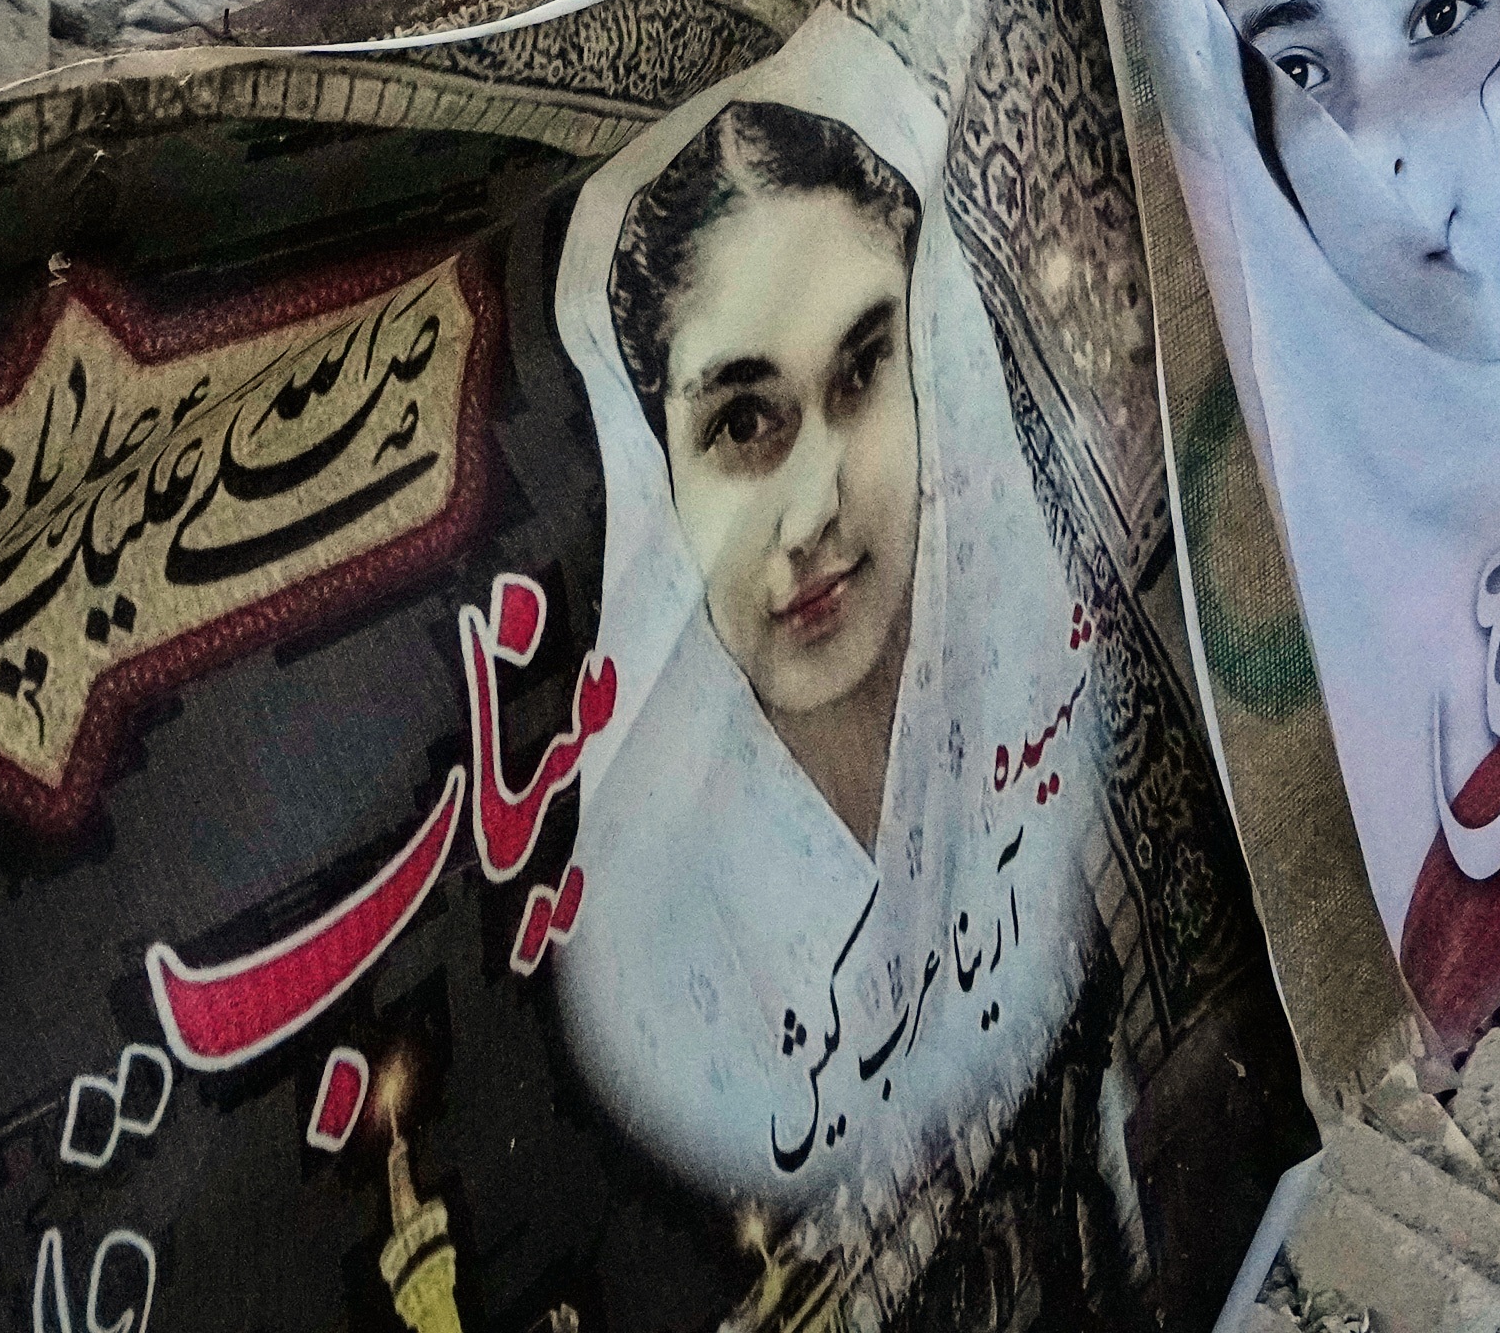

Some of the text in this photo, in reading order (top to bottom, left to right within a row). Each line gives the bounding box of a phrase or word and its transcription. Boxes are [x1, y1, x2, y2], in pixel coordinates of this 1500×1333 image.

[145, 571, 616, 1151] میناب
[993, 603, 1092, 805] شهیده
[770, 824, 1025, 1174] آرینا عرب کیش
